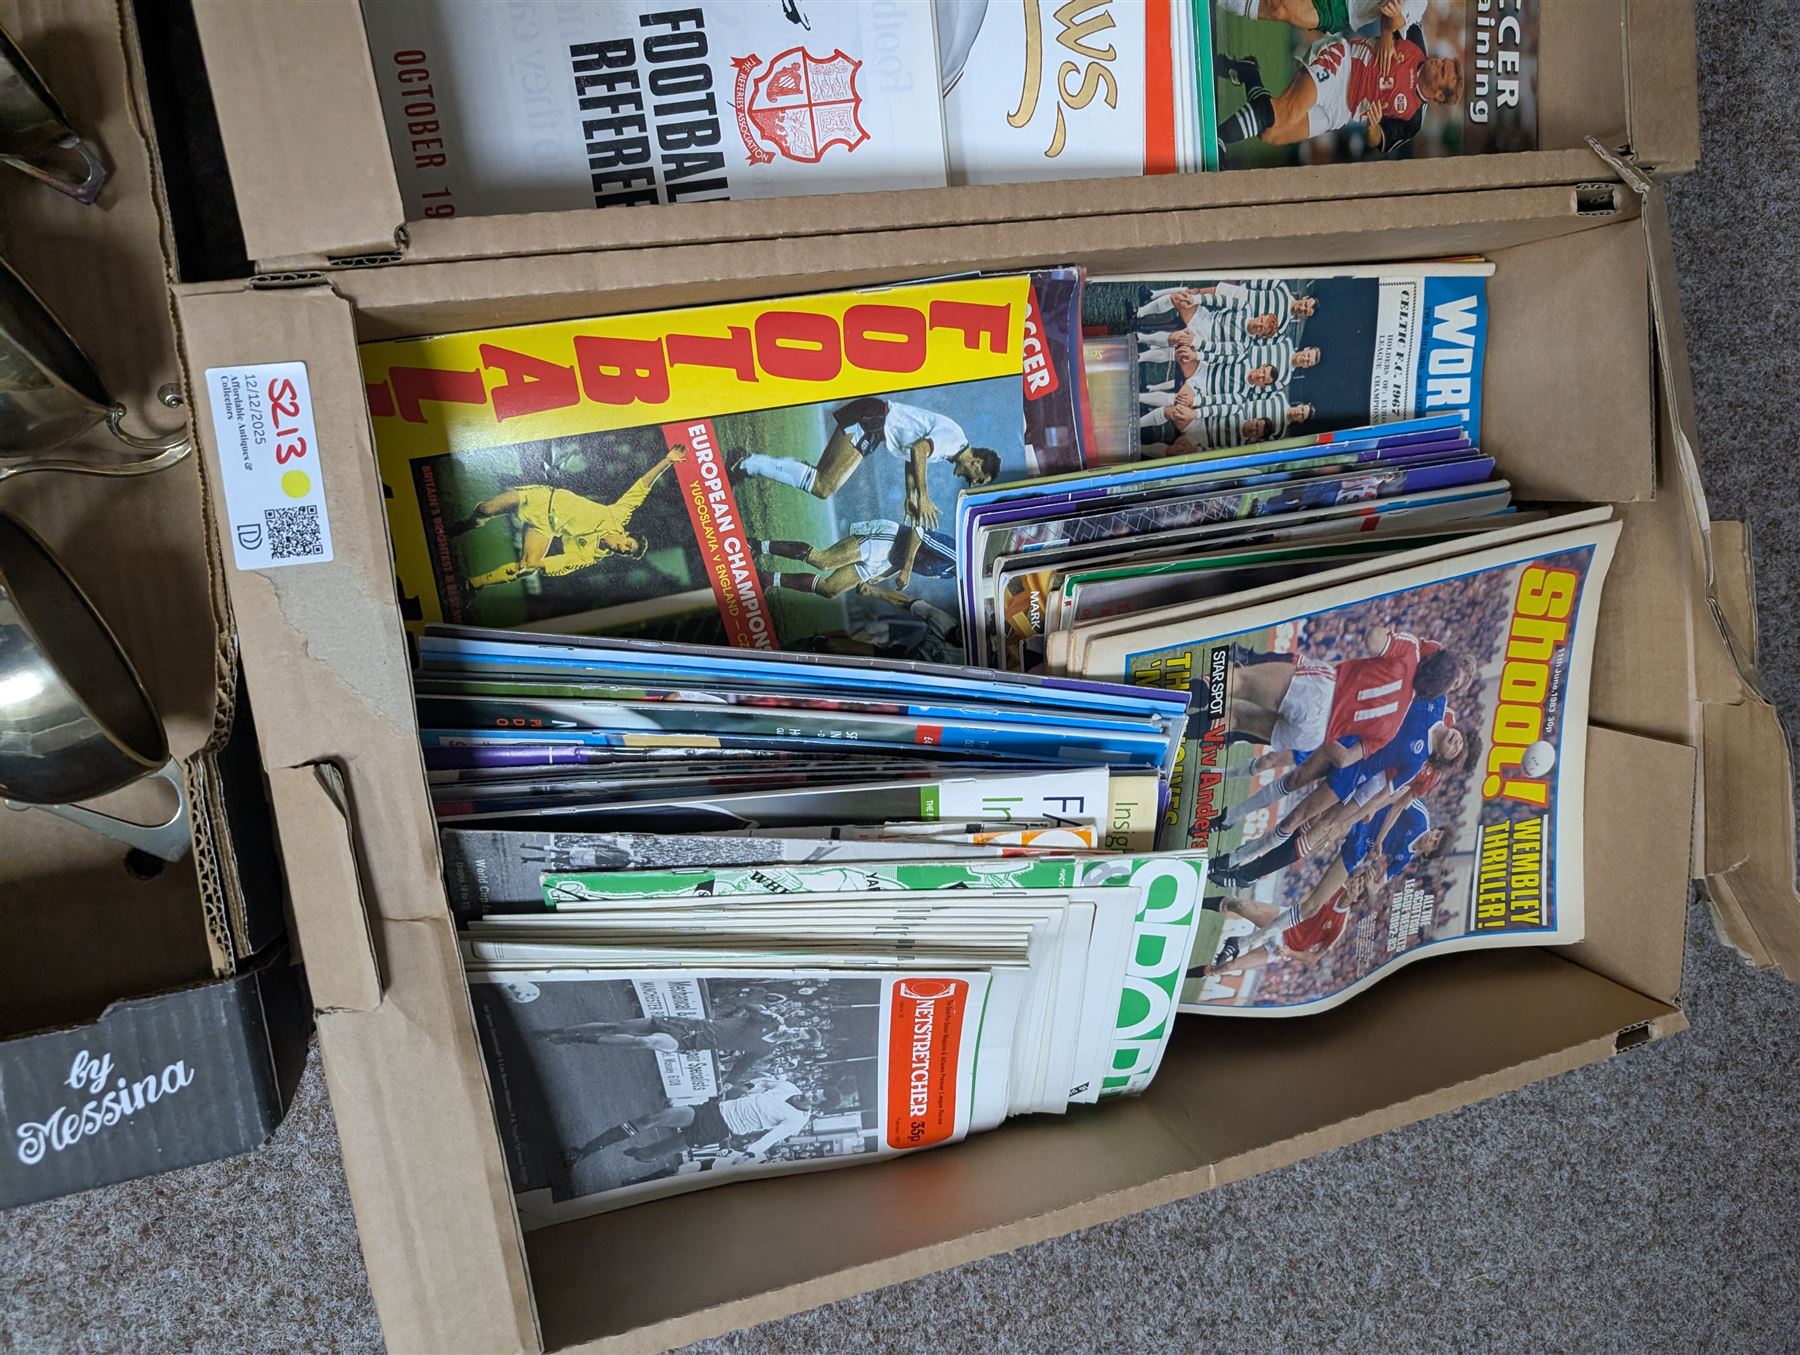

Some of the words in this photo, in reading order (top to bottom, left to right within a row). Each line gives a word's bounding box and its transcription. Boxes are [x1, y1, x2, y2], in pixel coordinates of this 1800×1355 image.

[393, 50, 447, 169] OCTOBER
[639, 8, 731, 203] FOOTBAL
[736, 111, 771, 163] ASSOCIATION
[1396, 290, 1410, 348] CELTIC
[1375, 335, 1385, 370] LEAGUE
[1383, 334, 1394, 375] HOLDERS
[1392, 351, 1404, 379] F.C.
[220, 375, 235, 421] Collectors
[229, 374, 246, 422] Affordable
[244, 374, 267, 446] 12/12/2025
[1391, 384, 1402, 417] 1967
[236, 422, 251, 461] Antiques
[244, 462, 253, 471] &
[687, 423, 736, 533] EUROPEAN
[421, 464, 441, 516] BRITAIN'S
[432, 517, 452, 573] BRIGHTEST
[689, 480, 719, 553] YUGOSLAVIA
[714, 565, 740, 616] ENGLAND
[1029, 591, 1041, 630] MARK
[1212, 650, 1226, 682] STAR
[1555, 647, 1565, 668] 11th
[1210, 684, 1224, 714] SPOT
[1353, 678, 1403, 722] 11
[1545, 716, 1556, 733] 30p
[1201, 724, 1226, 766] Viv
[475, 859, 489, 883] World
[1510, 817, 1542, 924] WEMBLEY
[479, 886, 490, 903] Cup
[1392, 891, 1403, 911] FOR
[1401, 878, 1416, 913] LEAGUE
[1408, 889, 1424, 935] SCOTTISH
[1422, 894, 1435, 909] ALL
[1386, 911, 1400, 952] 1982-83
[1396, 914, 1411, 952] RESULTS
[1420, 910, 1433, 927] THE
[640, 982, 664, 1010] MANCHESTER
[668, 980, 697, 1011] Mechanical
[684, 1062, 710, 1091] Specialists
[64, 1049, 115, 1094] by
[909, 999, 935, 1117] NETSTRETCHER
[16, 1059, 195, 1165] Messina
[937, 1092, 945, 1108] League
[908, 1121, 926, 1142] 35p
